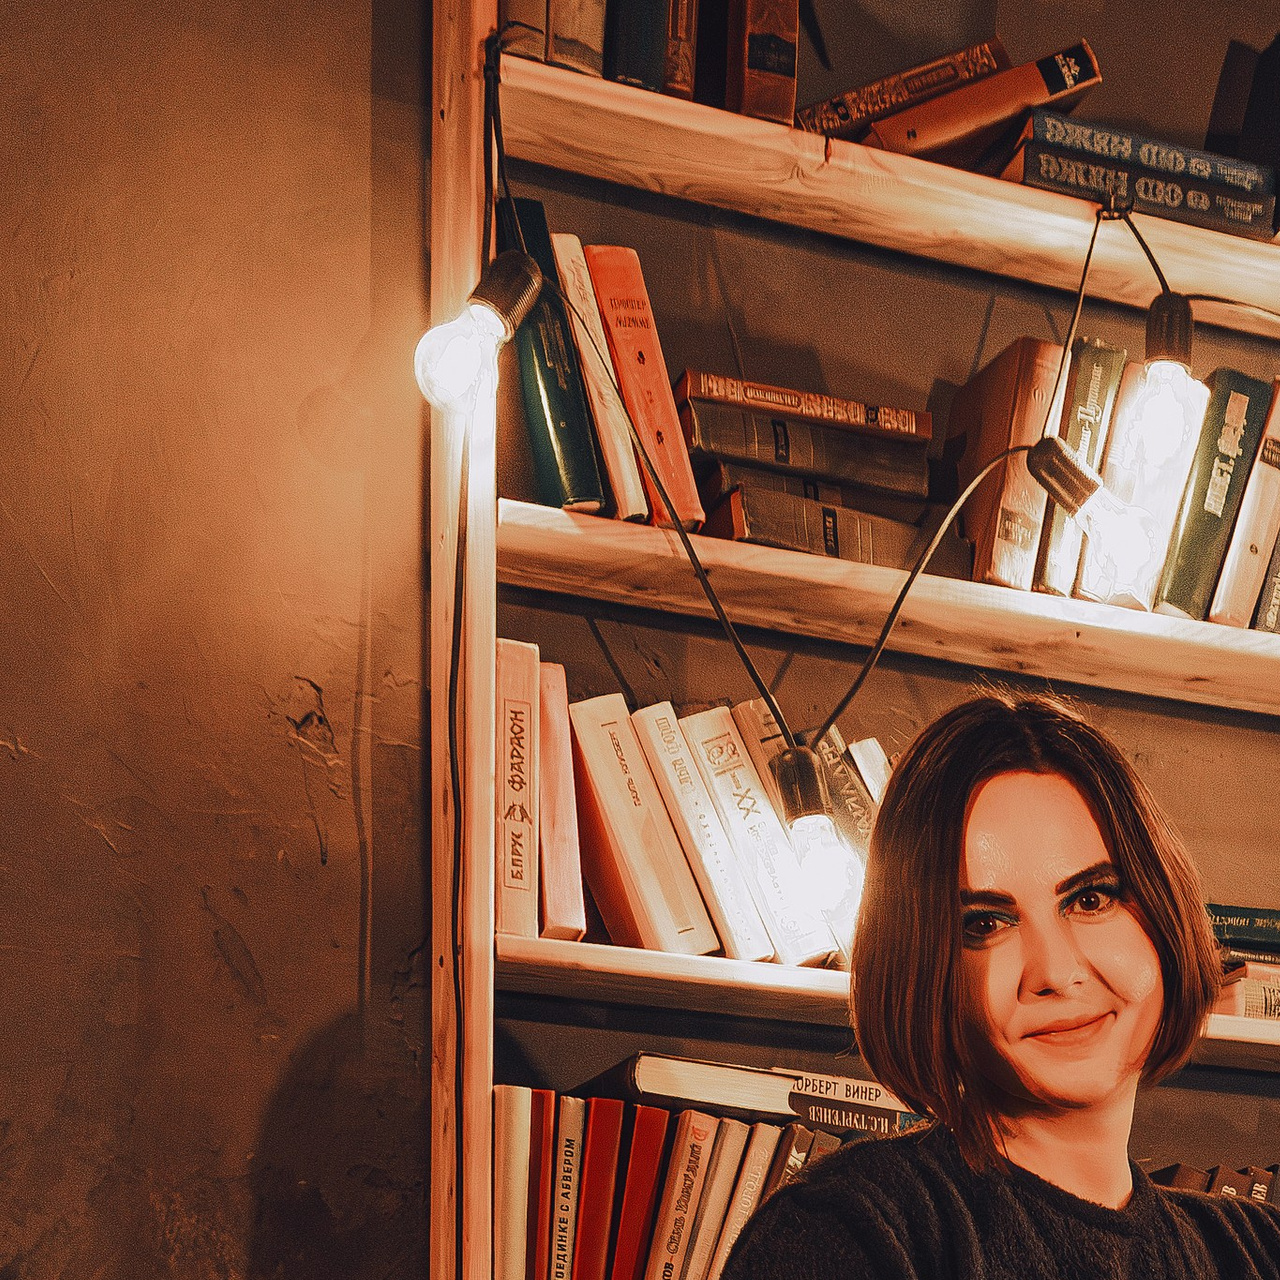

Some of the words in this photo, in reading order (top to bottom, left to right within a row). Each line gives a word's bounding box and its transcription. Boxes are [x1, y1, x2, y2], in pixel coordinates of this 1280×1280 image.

[510, 710, 526, 792] ФАРАОН
[843, 1083, 883, 1102] ВИНЕР
[804, 1106, 892, 1131] И.С.ТУРГЕНЕВ
[561, 1137, 575, 1200] АБВЕРОМ
